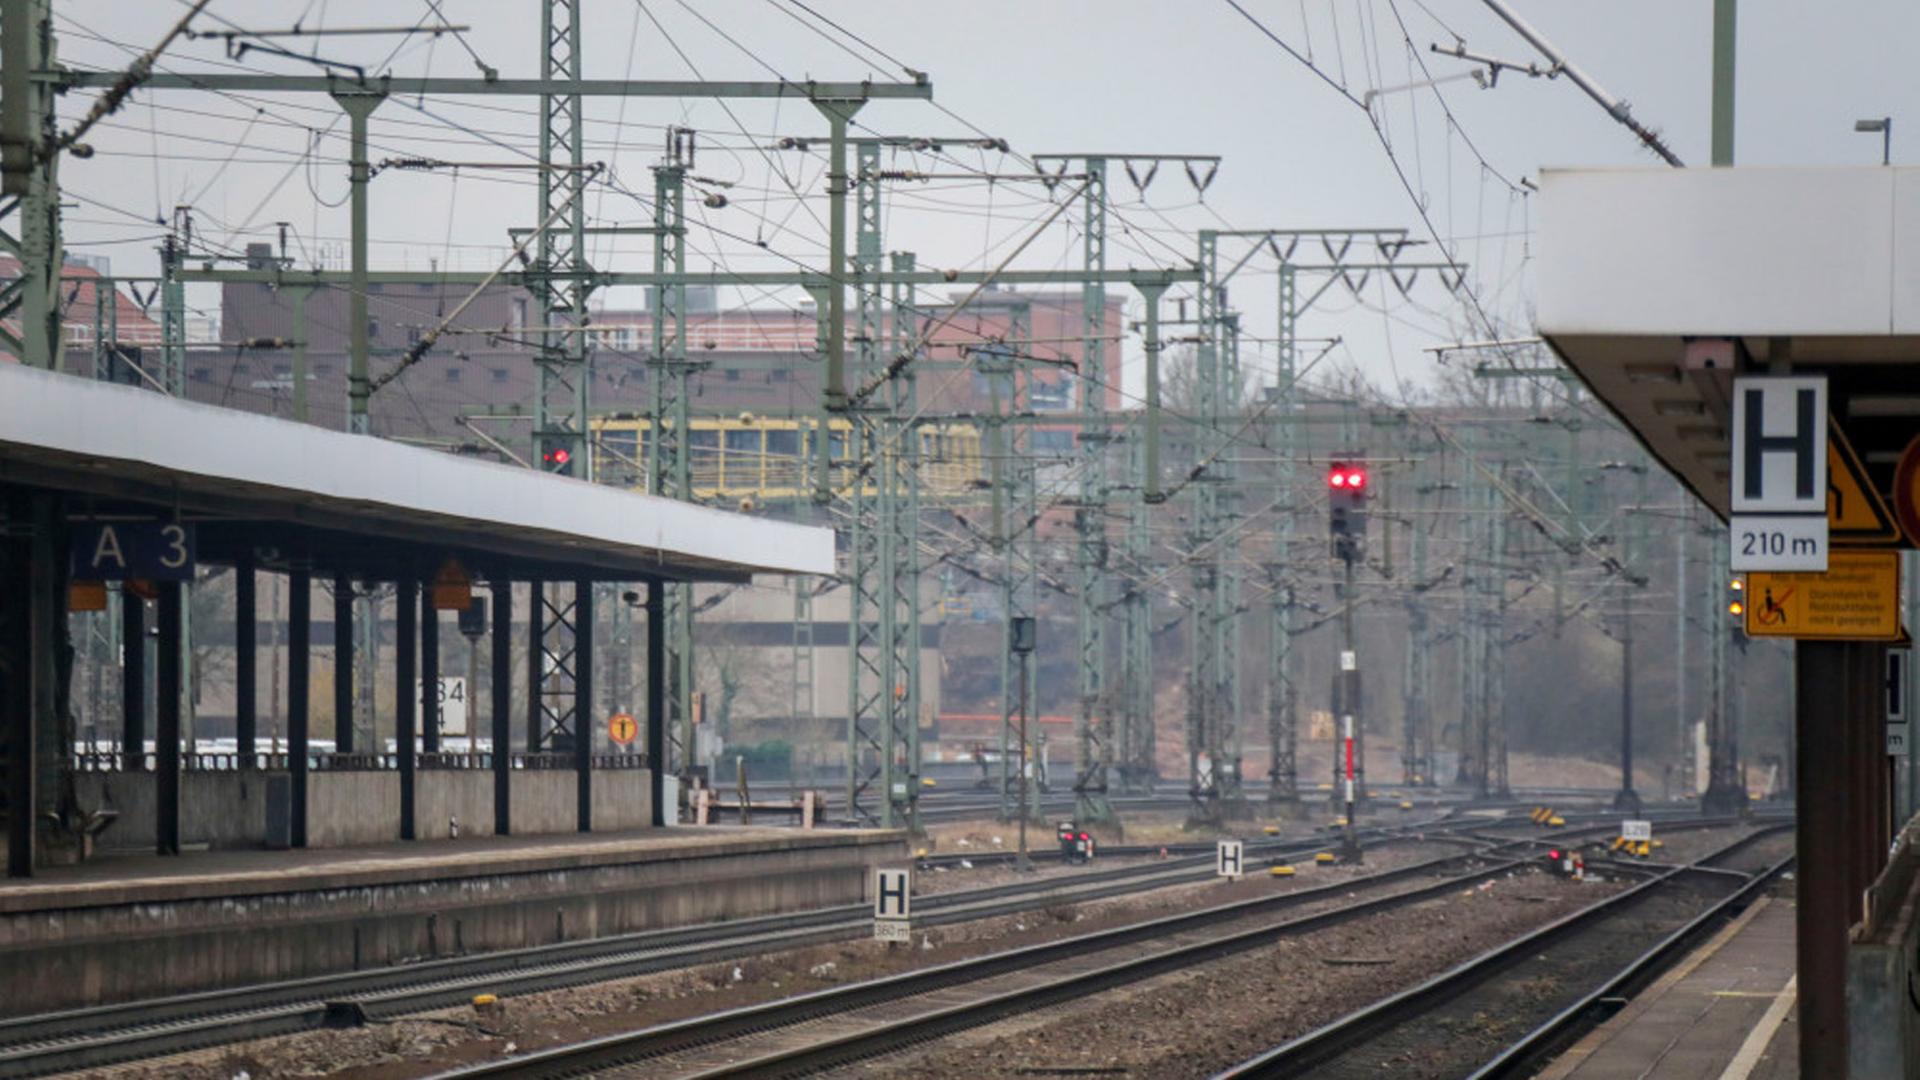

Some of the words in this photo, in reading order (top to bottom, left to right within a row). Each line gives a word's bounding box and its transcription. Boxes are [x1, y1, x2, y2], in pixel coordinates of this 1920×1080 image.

[1744, 389, 1815, 499] H
[92, 525, 126, 568] A
[159, 525, 187, 568] 3
[1742, 531, 1785, 557] 210
[1792, 538, 1817, 556] m
[1221, 845, 1239, 873] H
[879, 873, 905, 915] H
